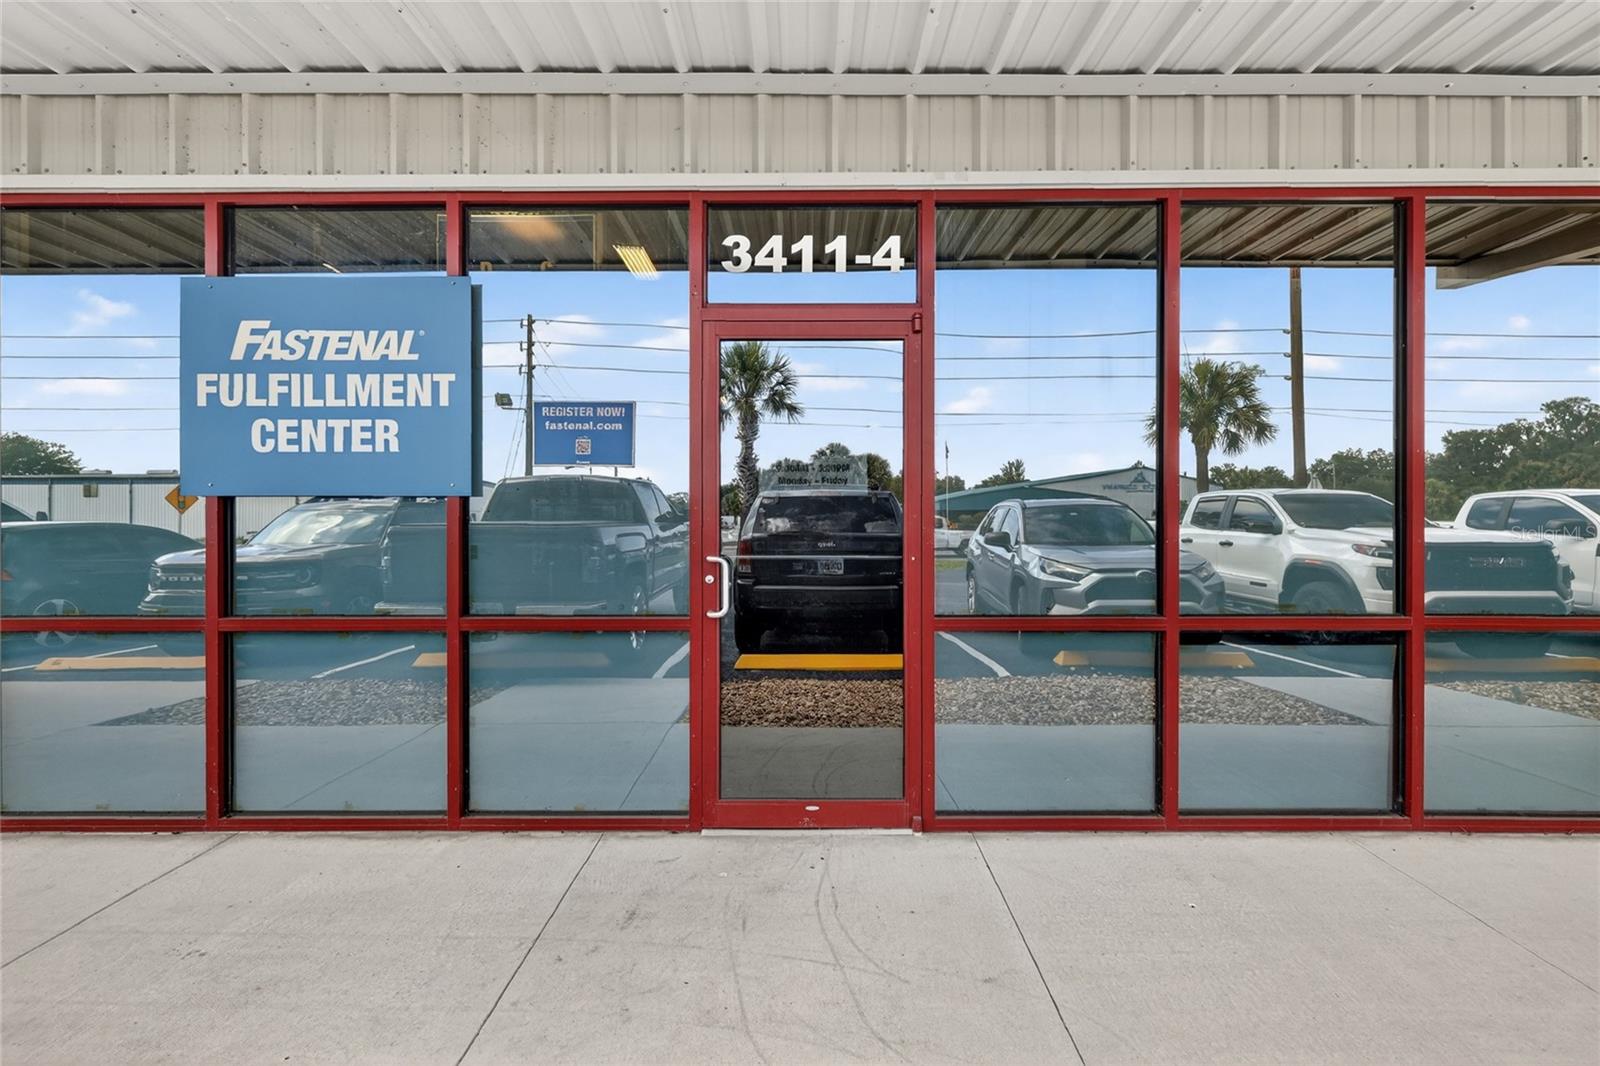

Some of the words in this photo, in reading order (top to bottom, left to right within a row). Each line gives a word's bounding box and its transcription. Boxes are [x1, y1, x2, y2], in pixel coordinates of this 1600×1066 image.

[720, 234, 905, 273] 3411-4
[229, 320, 420, 361] FASTENAL
[196, 373, 456, 407] FULFILLMENT
[542, 406, 594, 417] REGISTER
[596, 407, 625, 417] NOW!
[544, 421, 623, 431] fastenal.com
[250, 418, 400, 453] CENTER
[778, 476, 811, 486] Monday
[821, 476, 848, 486] Friday
